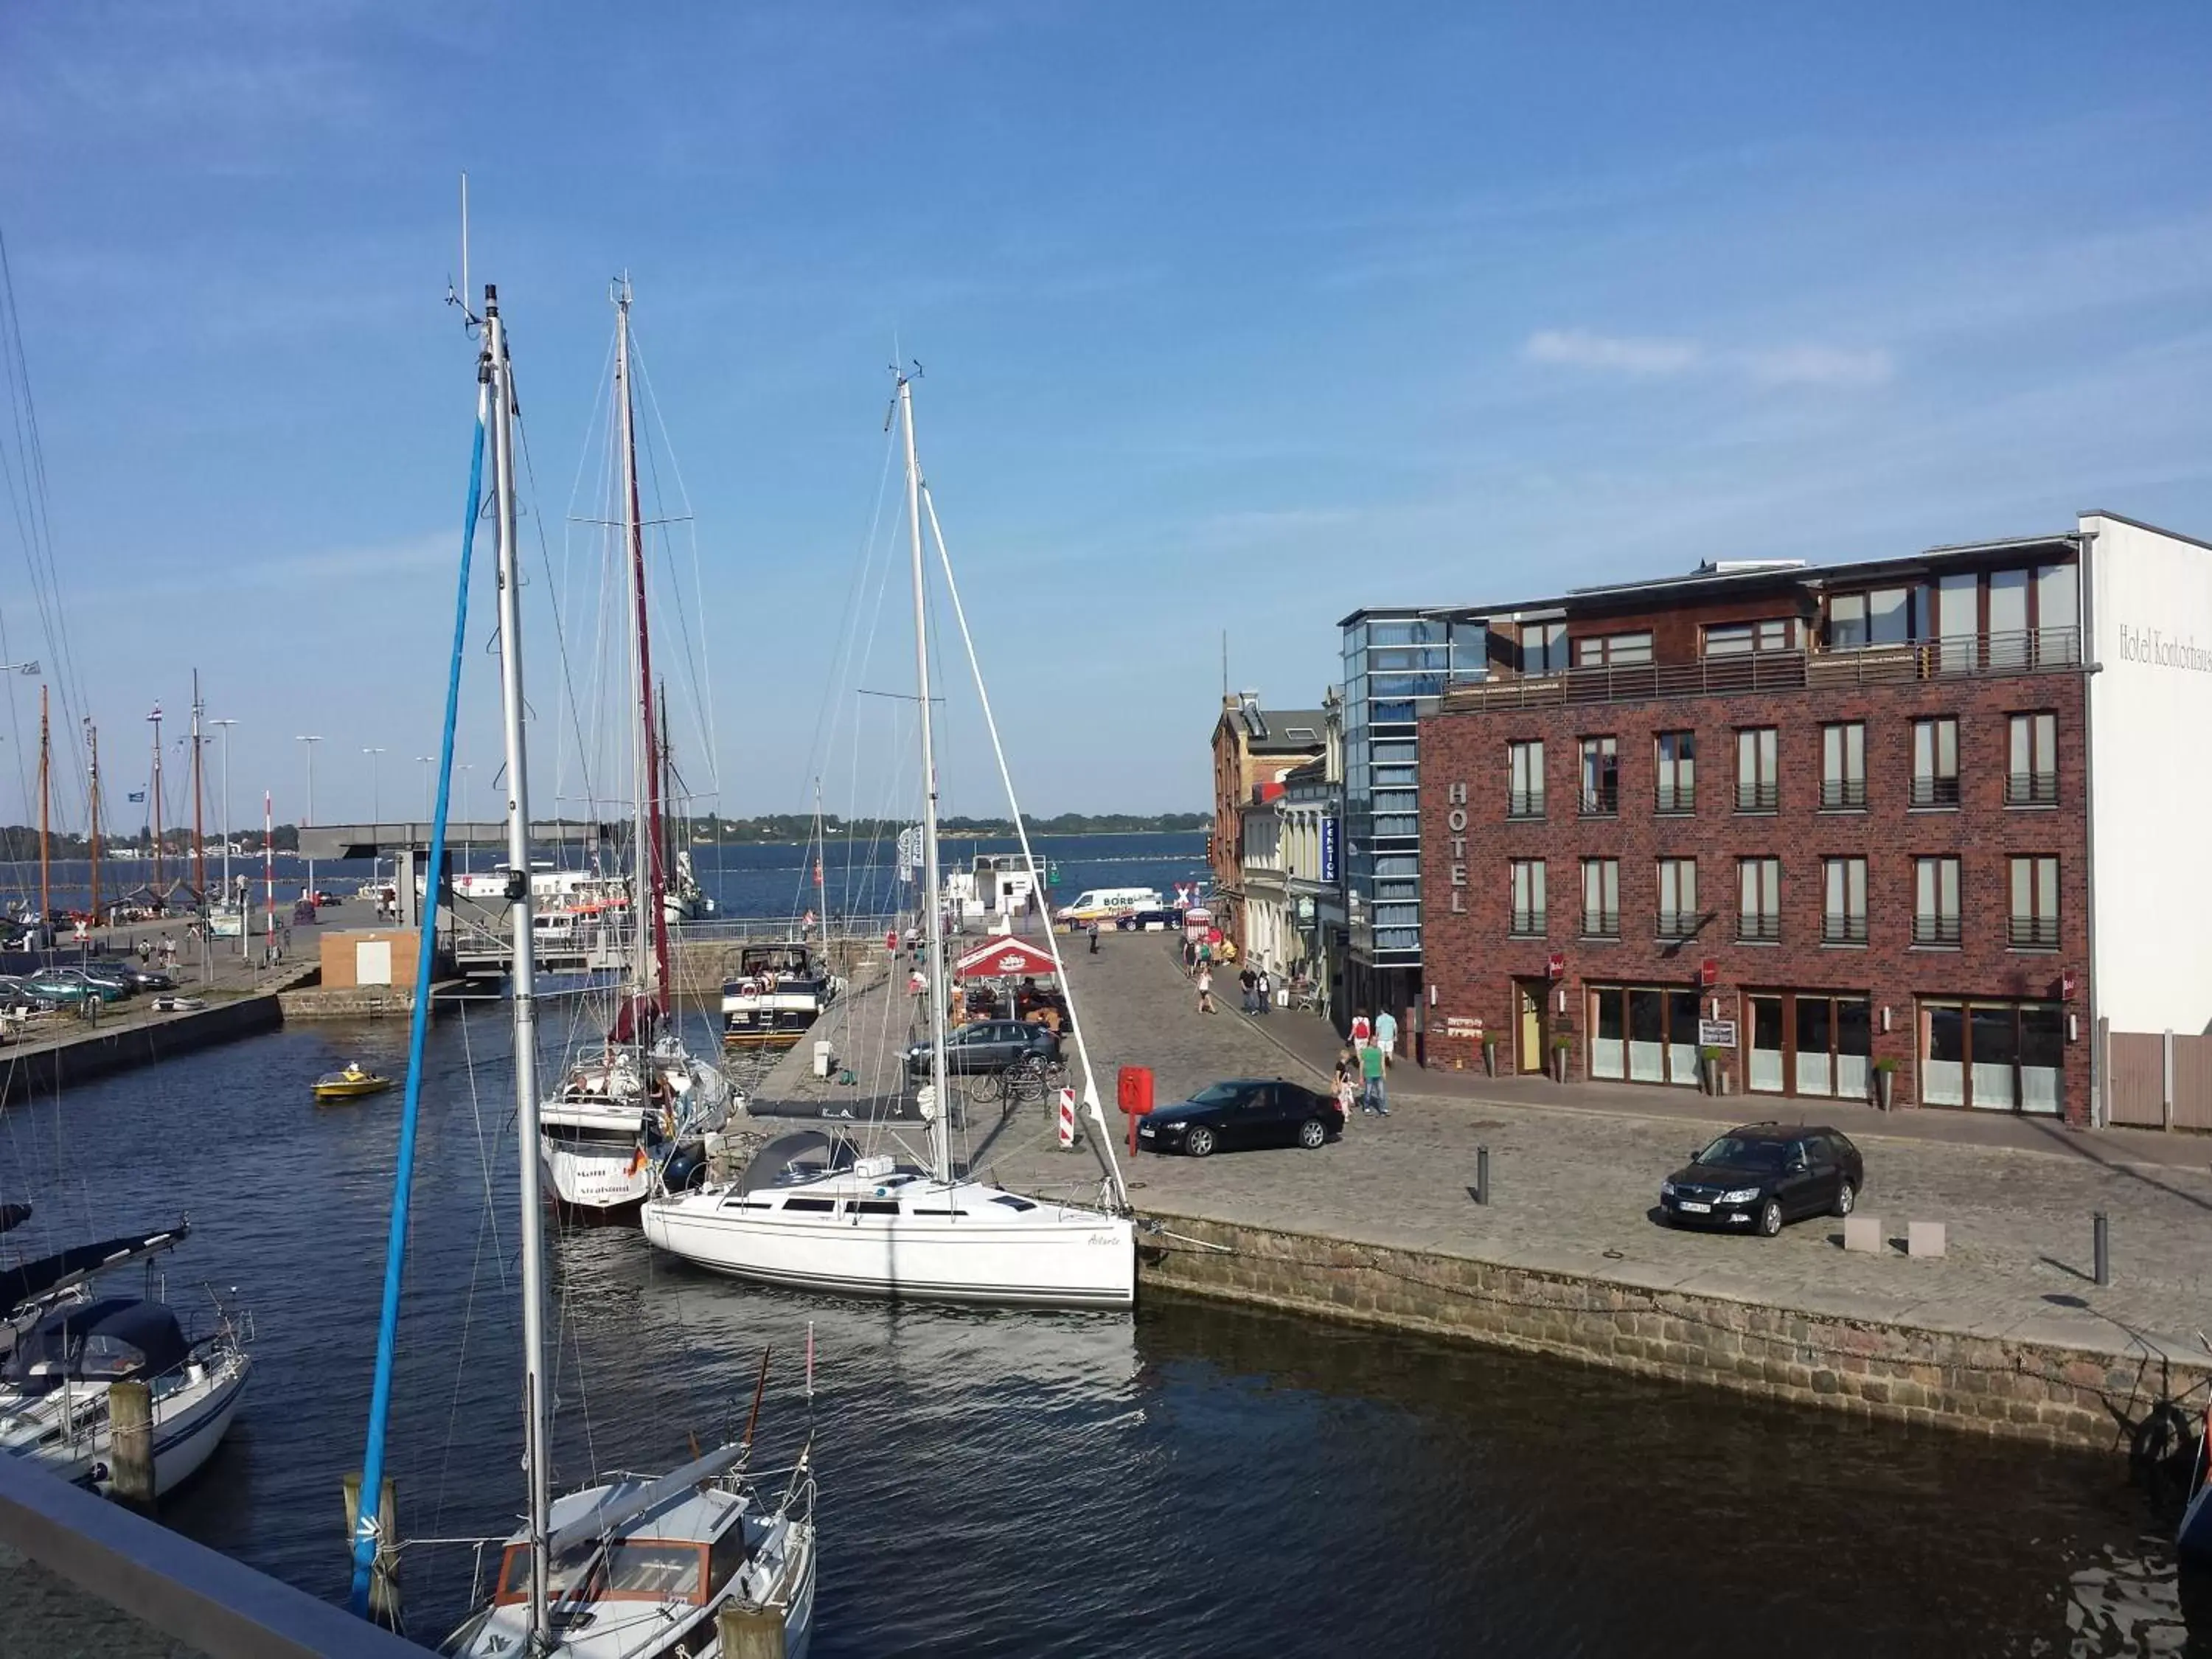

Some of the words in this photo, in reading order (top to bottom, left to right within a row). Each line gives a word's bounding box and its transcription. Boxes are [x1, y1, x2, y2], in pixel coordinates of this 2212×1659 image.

[2120, 624, 2151, 663] Hotel
[1326, 819, 1335, 879] PENSION
[1449, 782, 1468, 913] HOTEL
